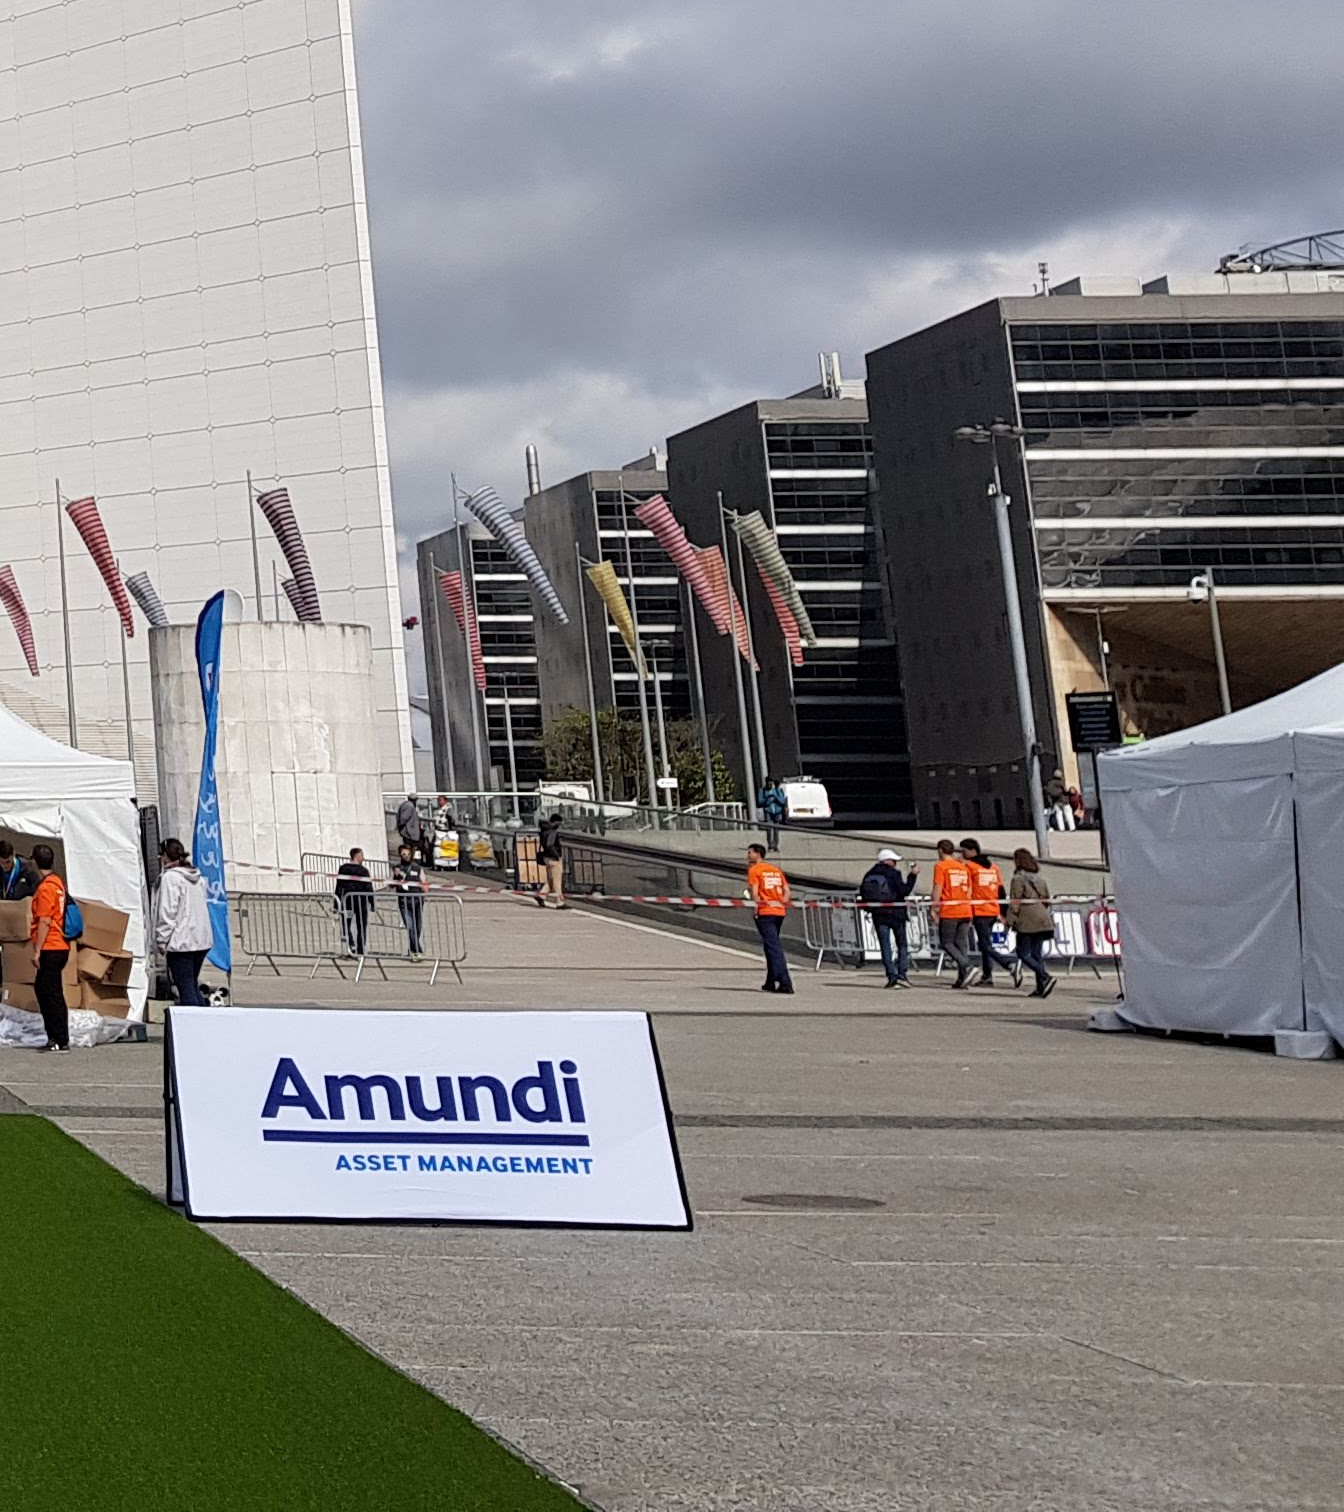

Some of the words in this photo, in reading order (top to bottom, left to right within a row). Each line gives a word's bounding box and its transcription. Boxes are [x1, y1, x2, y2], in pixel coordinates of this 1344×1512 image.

[261, 1057, 586, 1123] Amundi
[335, 1155, 411, 1171] ASSET
[418, 1155, 593, 1175] MANAGEMENT
